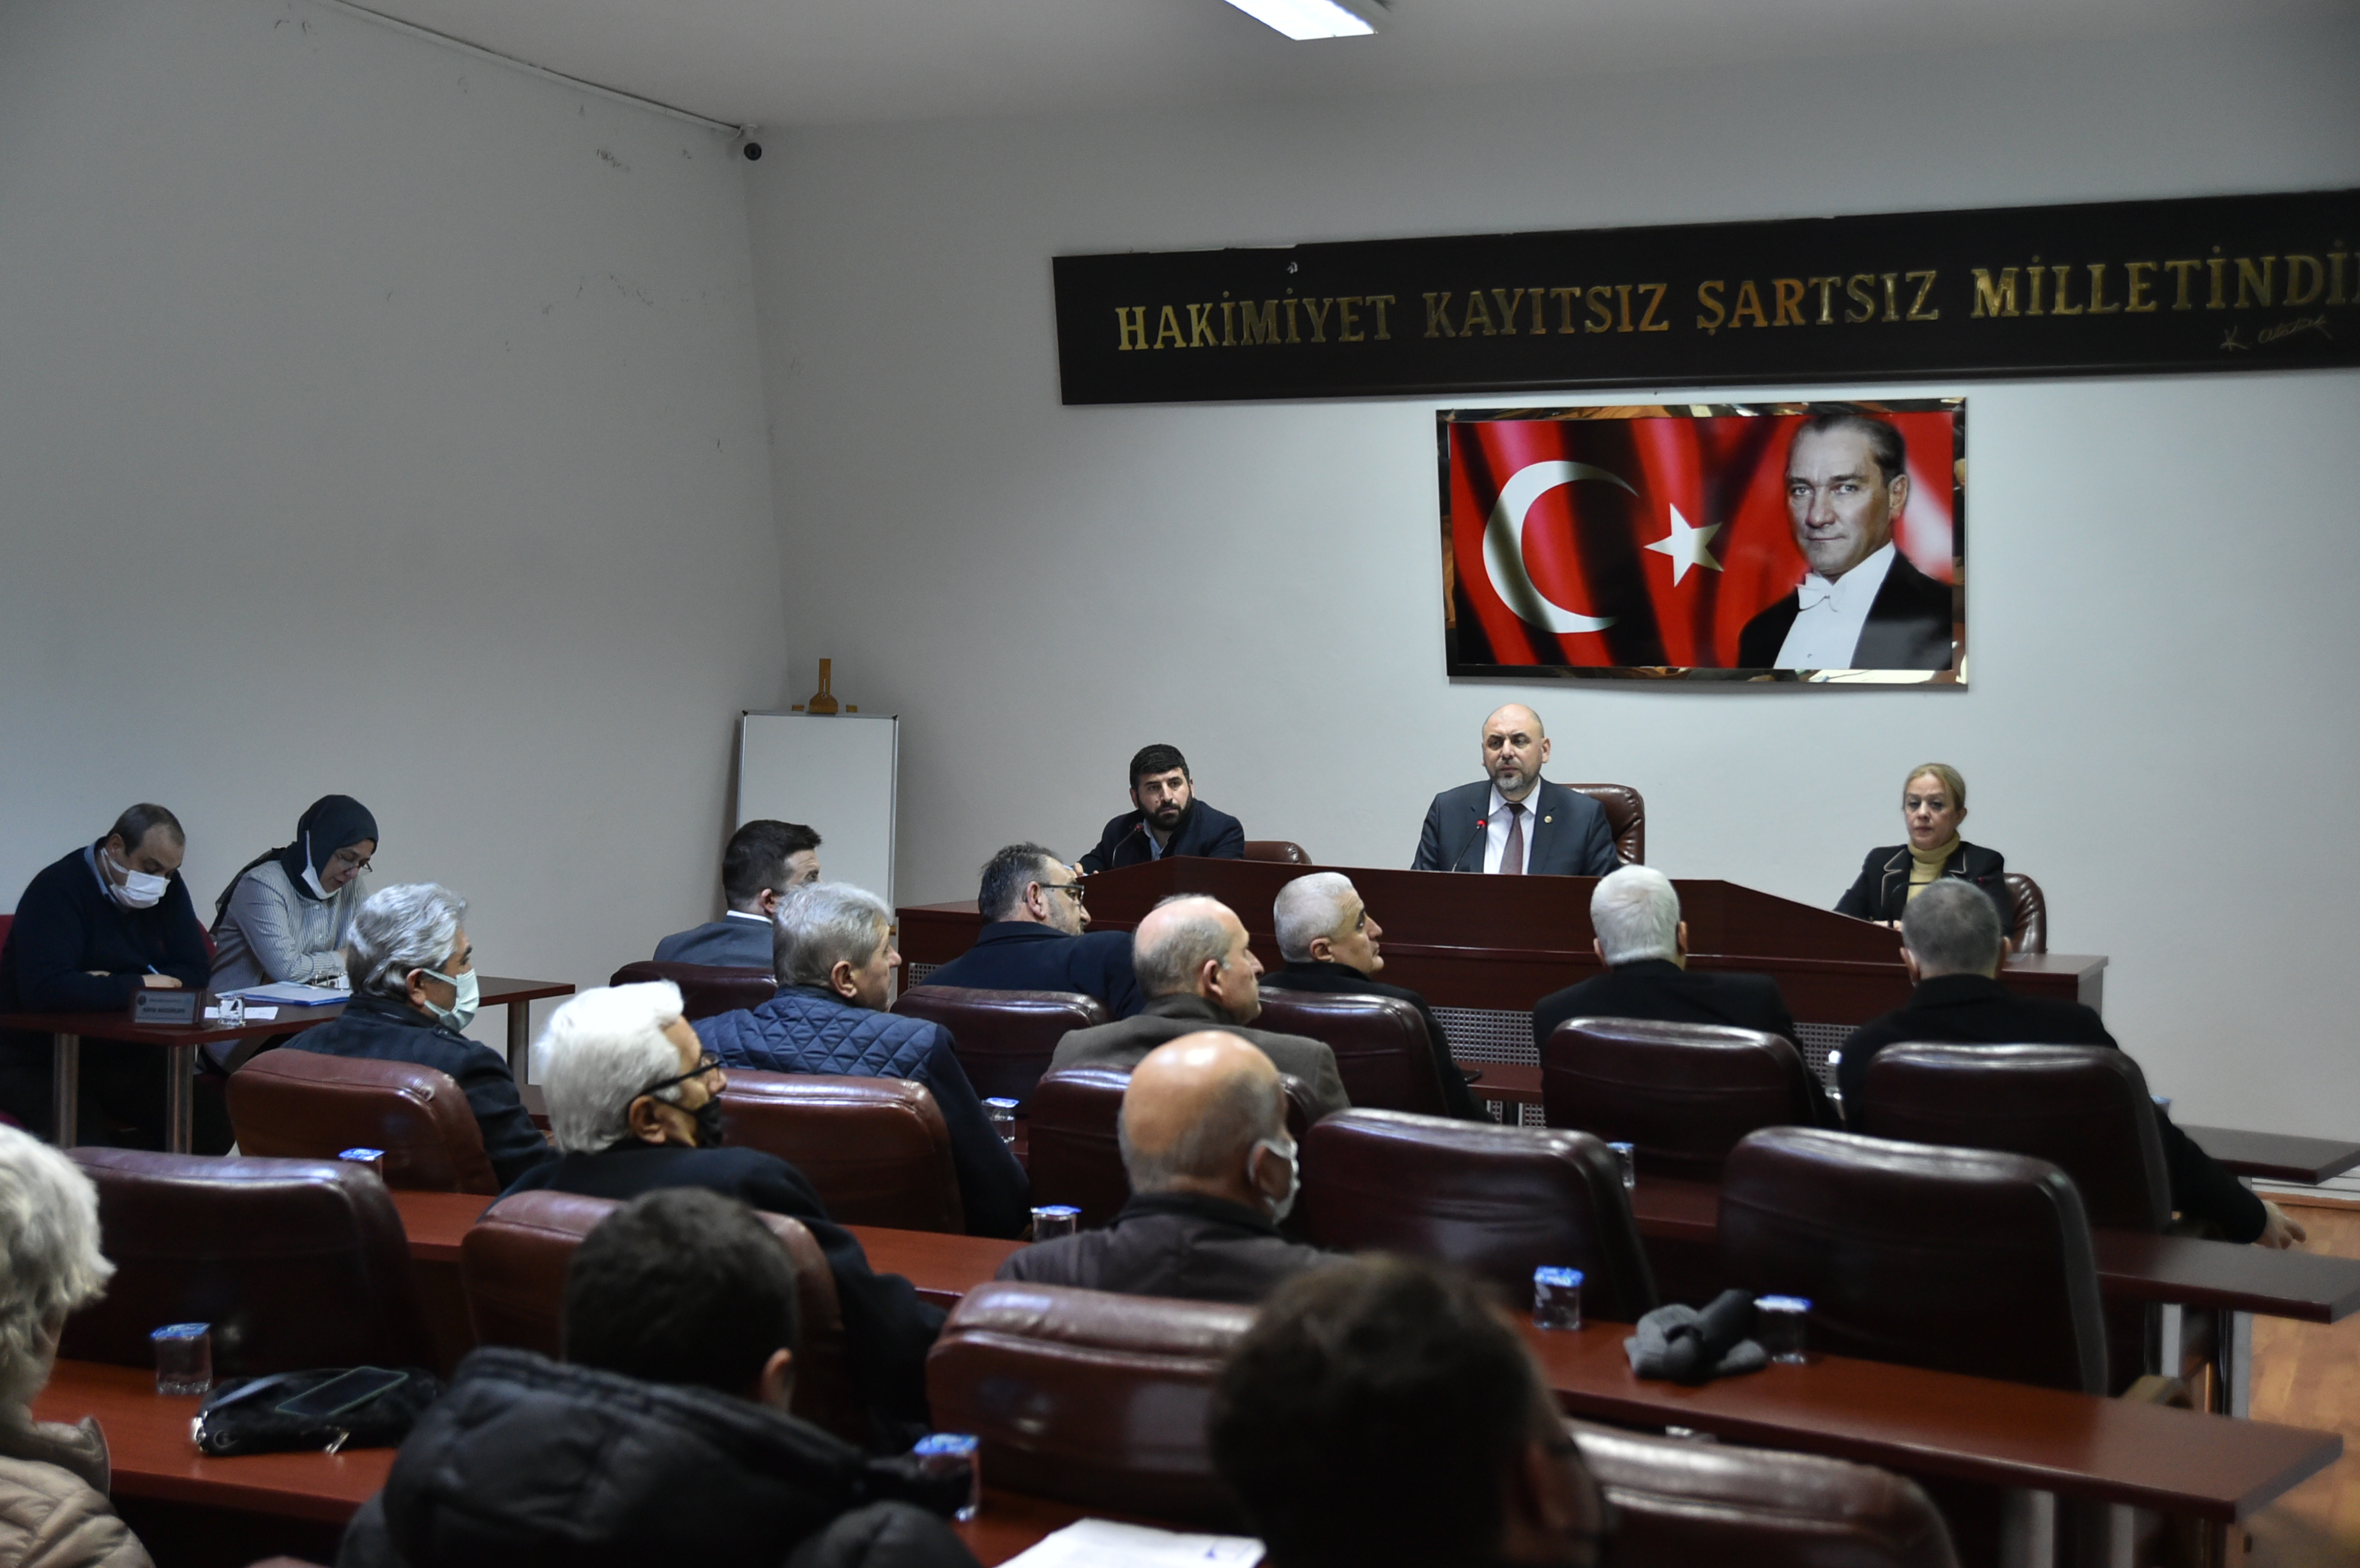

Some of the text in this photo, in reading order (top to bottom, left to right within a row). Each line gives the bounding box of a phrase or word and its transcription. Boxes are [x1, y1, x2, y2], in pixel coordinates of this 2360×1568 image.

[1116, 289, 1395, 351] HAKİMİYET
[1423, 283, 1668, 338] KAYITSIZ
[1697, 269, 1939, 336] ŞARTSIZ
